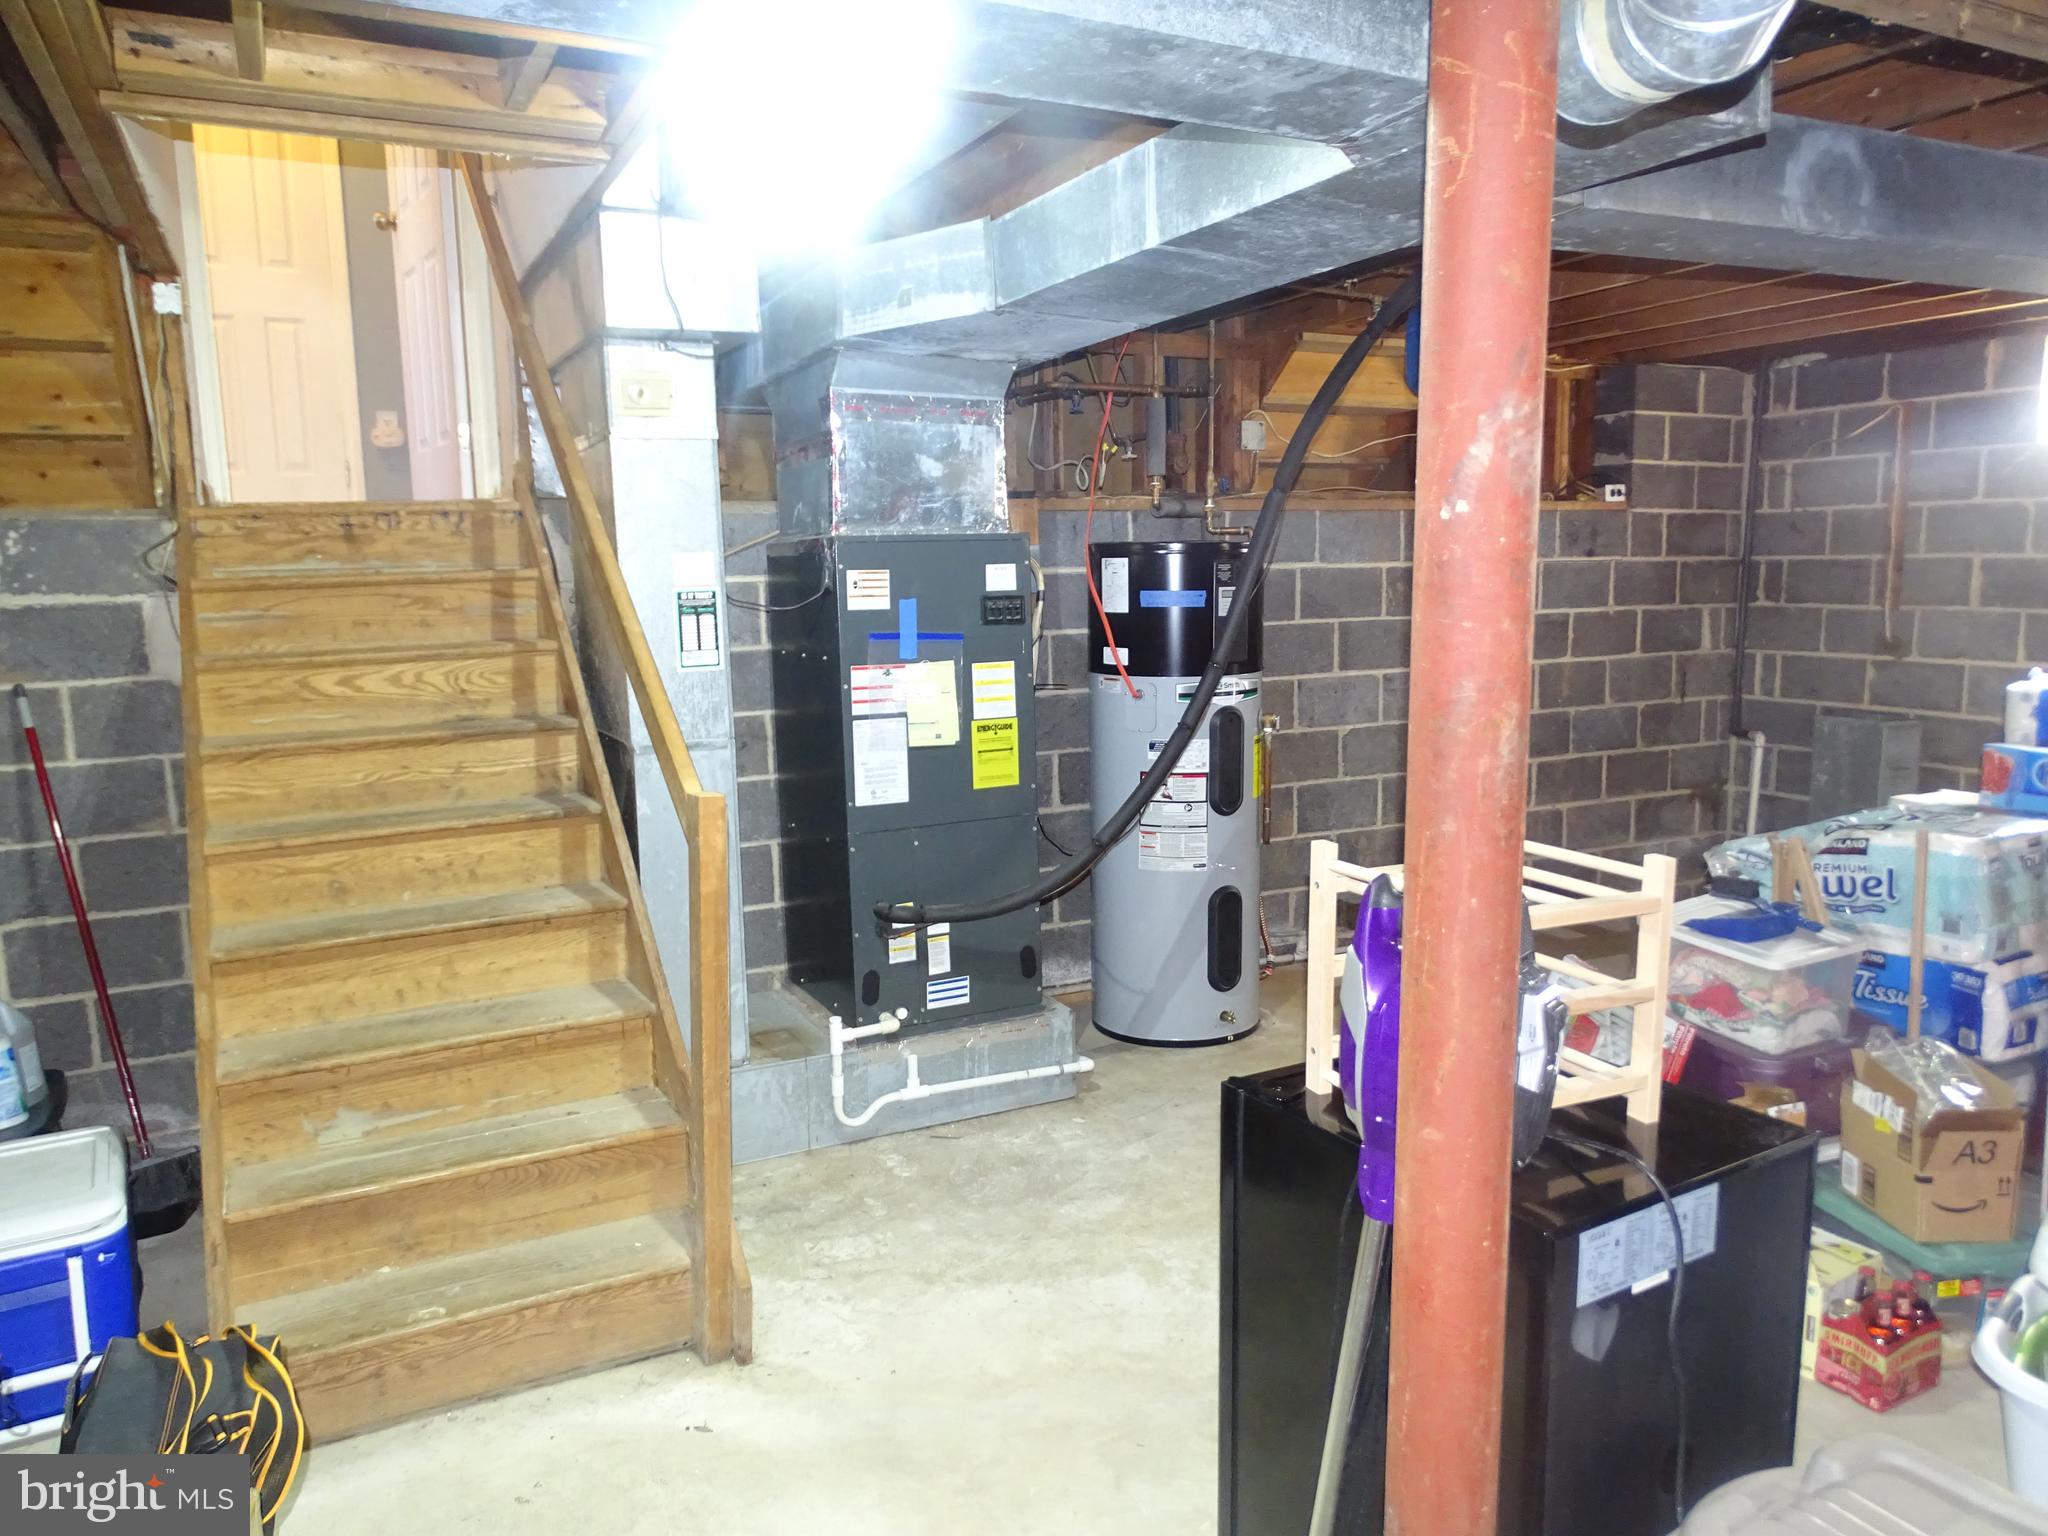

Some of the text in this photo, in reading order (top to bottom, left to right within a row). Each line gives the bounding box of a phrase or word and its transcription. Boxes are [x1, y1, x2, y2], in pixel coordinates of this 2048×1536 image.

[1812, 862, 1867, 873] REMIUM
[1796, 867, 1897, 901] wel
[1952, 1139, 1998, 1165] A3
